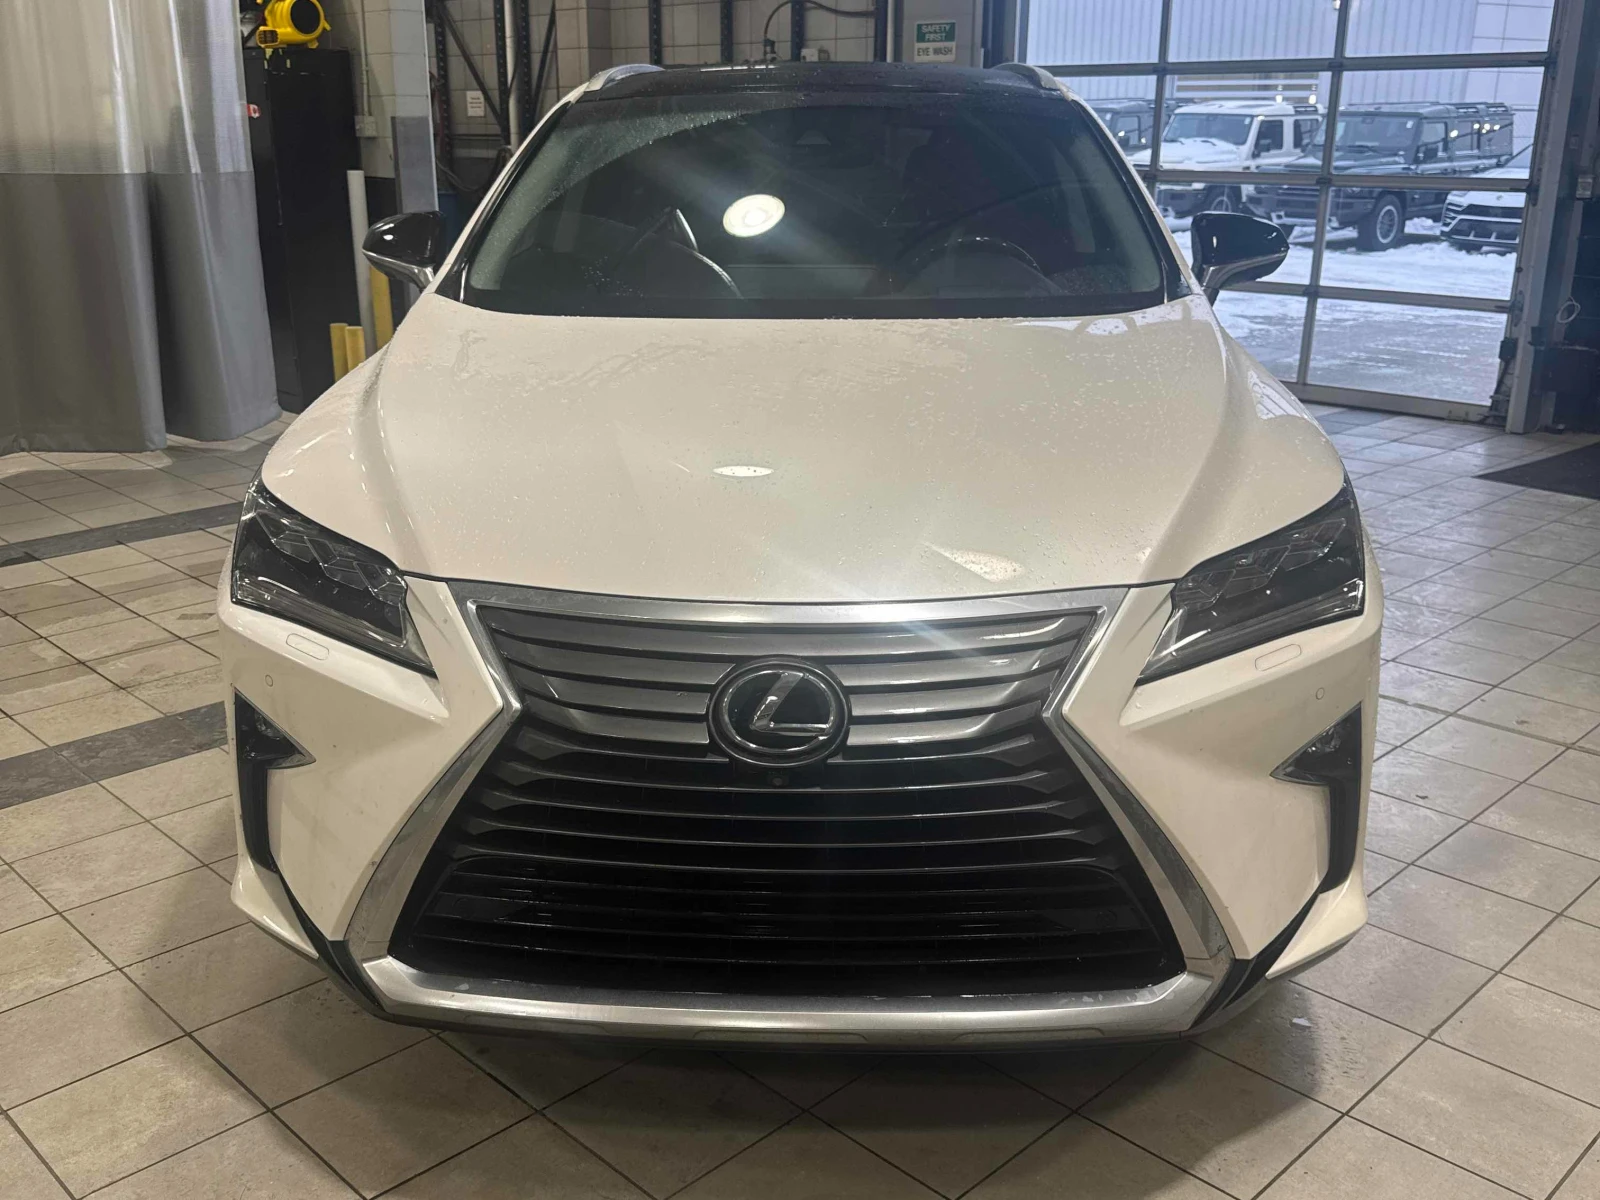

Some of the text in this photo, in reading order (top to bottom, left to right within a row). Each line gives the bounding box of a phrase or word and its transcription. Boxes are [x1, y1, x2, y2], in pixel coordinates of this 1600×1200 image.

[921, 24, 951, 33] SAFETY
[925, 33, 946, 41] FIRST
[917, 46, 953, 56] EYE WASH
